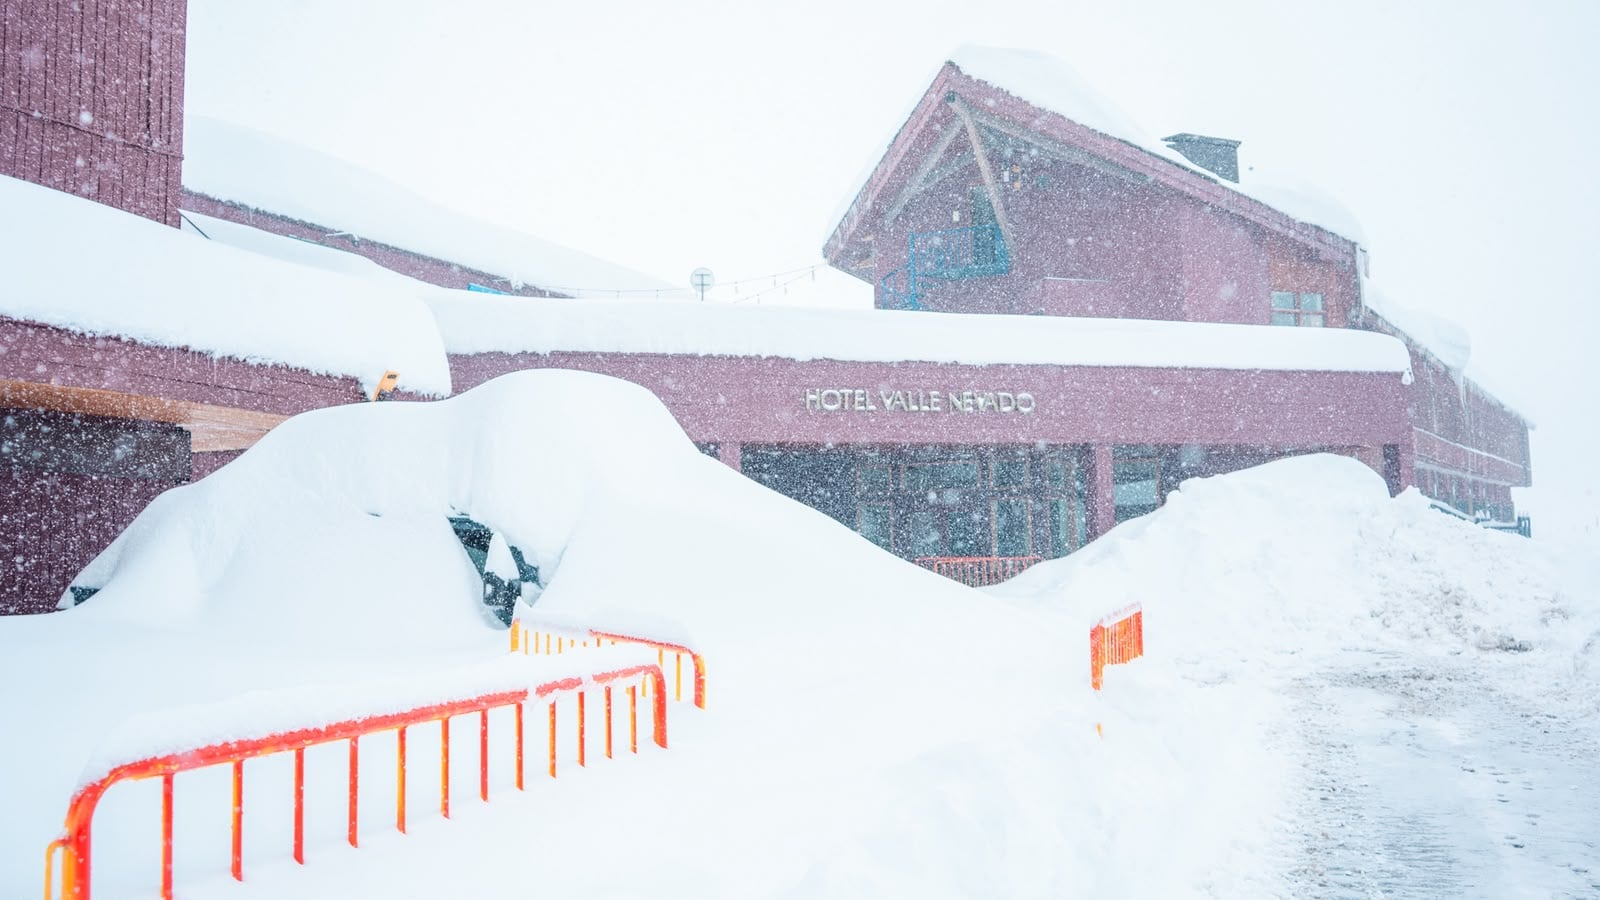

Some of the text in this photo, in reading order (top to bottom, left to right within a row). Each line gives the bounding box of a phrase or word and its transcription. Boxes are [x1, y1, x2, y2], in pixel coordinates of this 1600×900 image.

[805, 388, 1036, 414] HOTEL VALLE NEVADO
